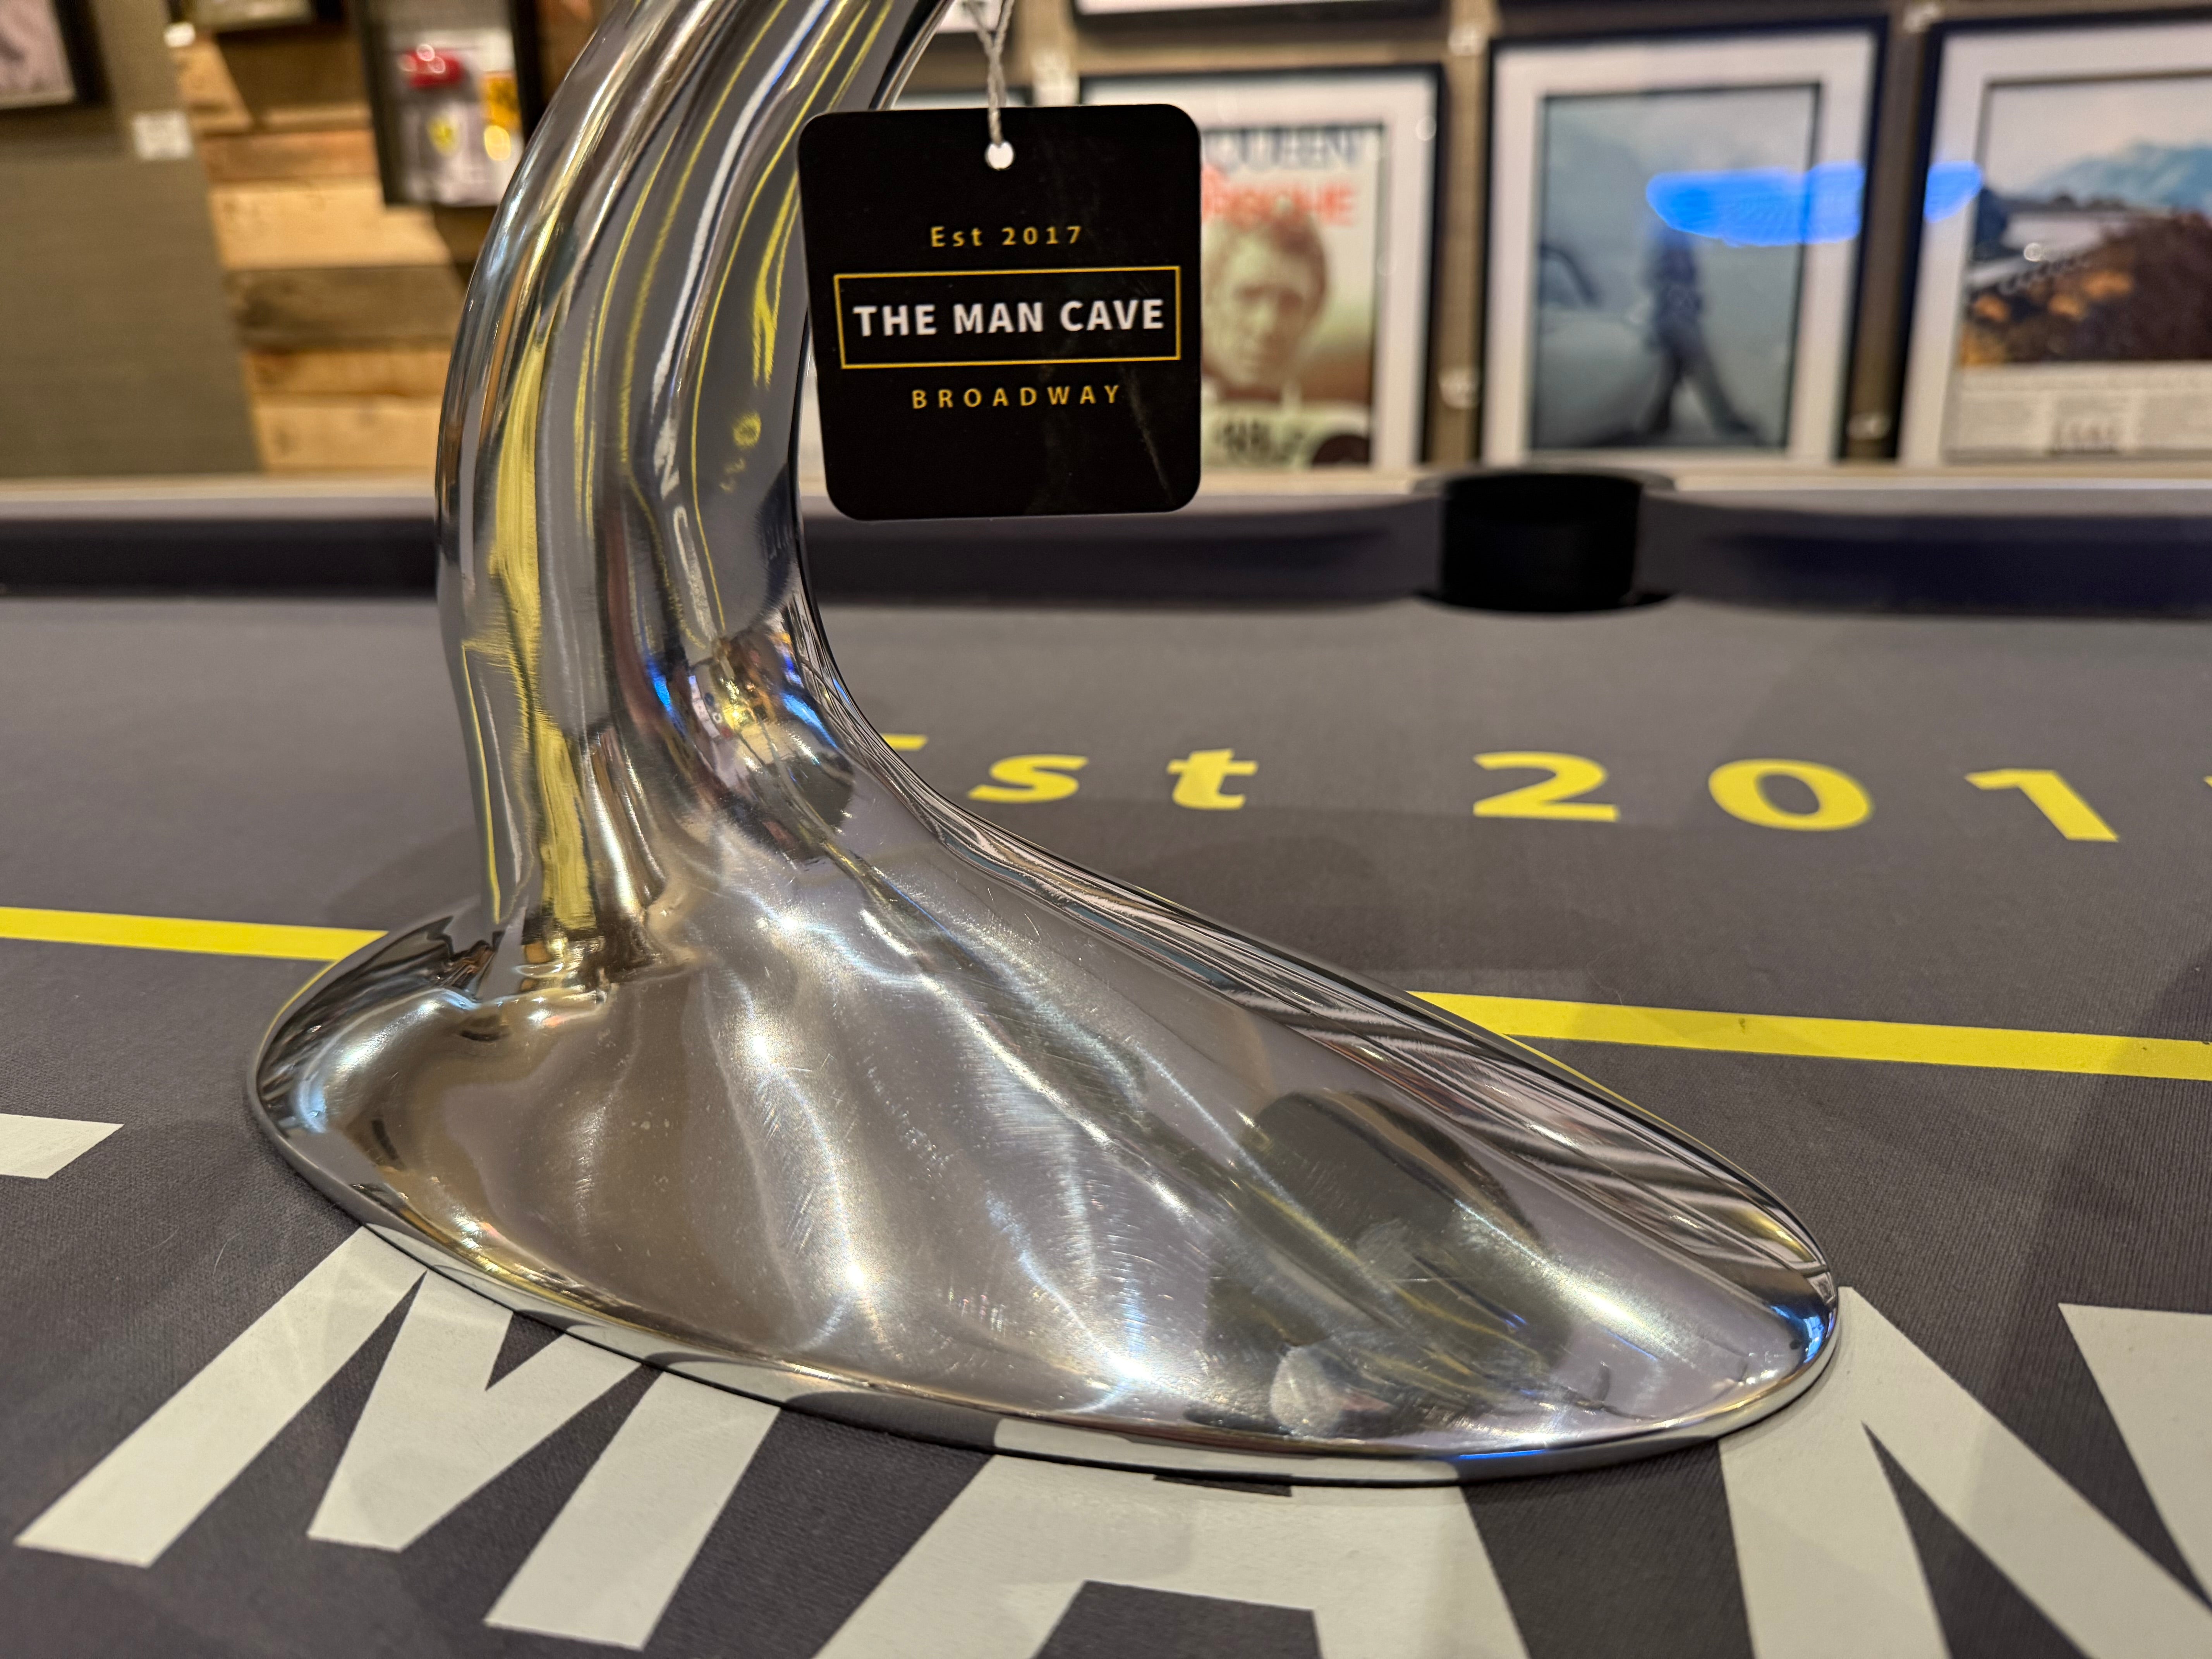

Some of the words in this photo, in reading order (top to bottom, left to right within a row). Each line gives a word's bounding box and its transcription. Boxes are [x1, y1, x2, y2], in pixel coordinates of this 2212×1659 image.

[931, 226, 982, 247] Est
[1001, 225, 1081, 246] 2017
[853, 304, 936, 336] THE
[953, 302, 1043, 334] MAN
[1060, 299, 1163, 331] CAVE
[912, 385, 1119, 409] BROADWAY
[878, 733, 1258, 810] st
[1472, 750, 2212, 842] 201
